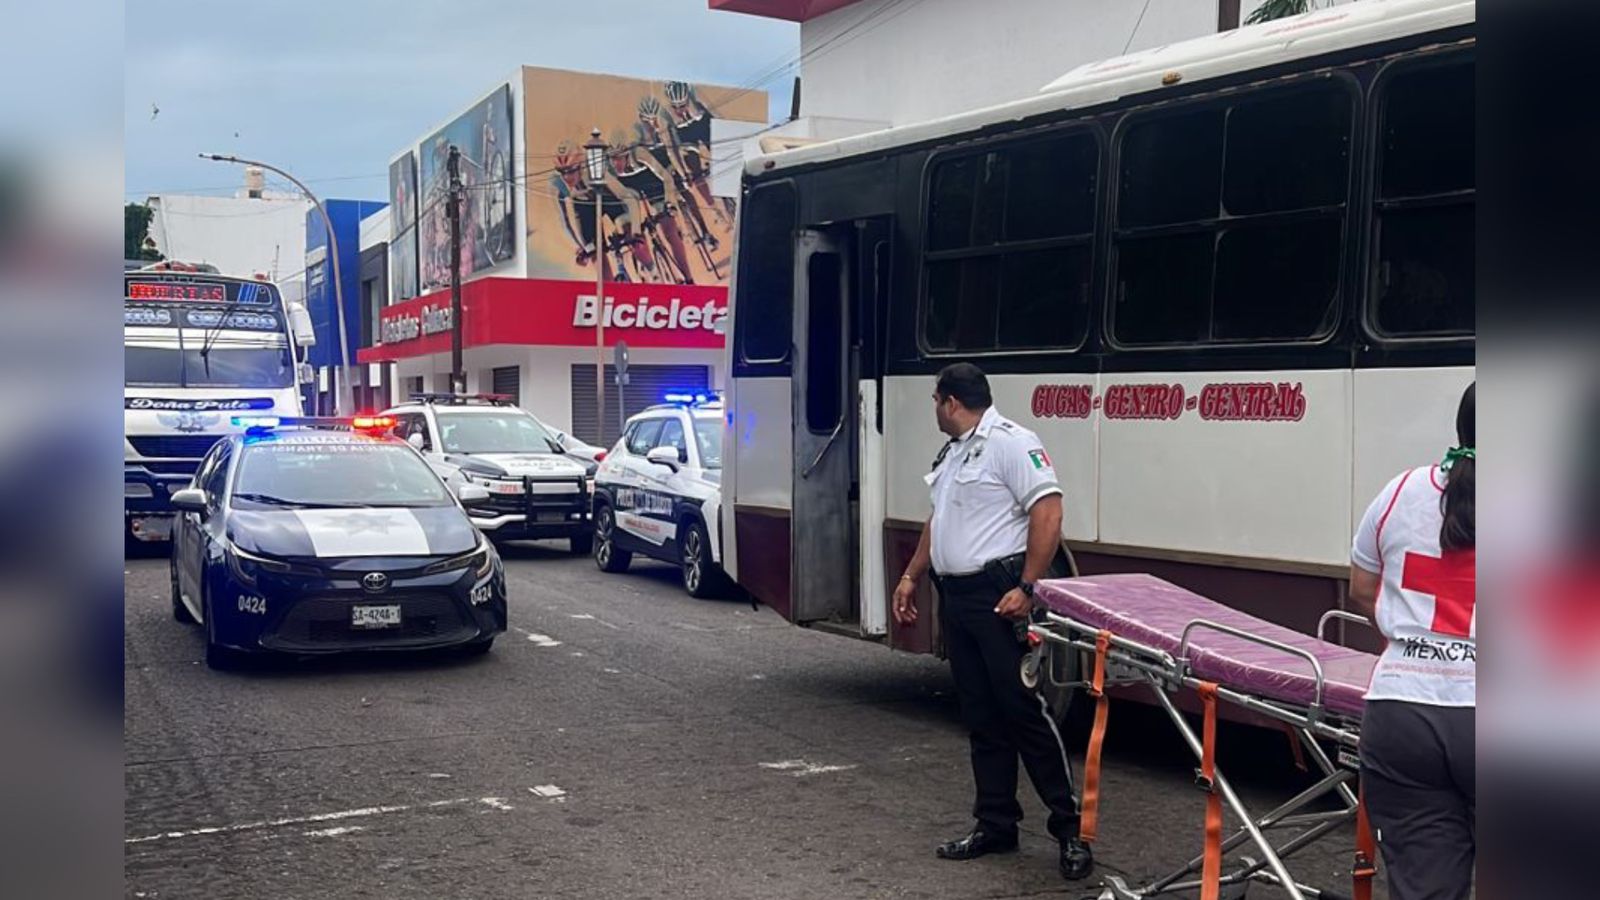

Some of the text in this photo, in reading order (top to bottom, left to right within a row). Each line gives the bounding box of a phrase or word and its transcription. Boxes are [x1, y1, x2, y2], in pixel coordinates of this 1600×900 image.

[130, 398, 190, 409] Doña
[1103, 383, 1185, 420] CENTRO
[1199, 382, 1306, 421] CENTRAL
[238, 594, 266, 615] 0424
